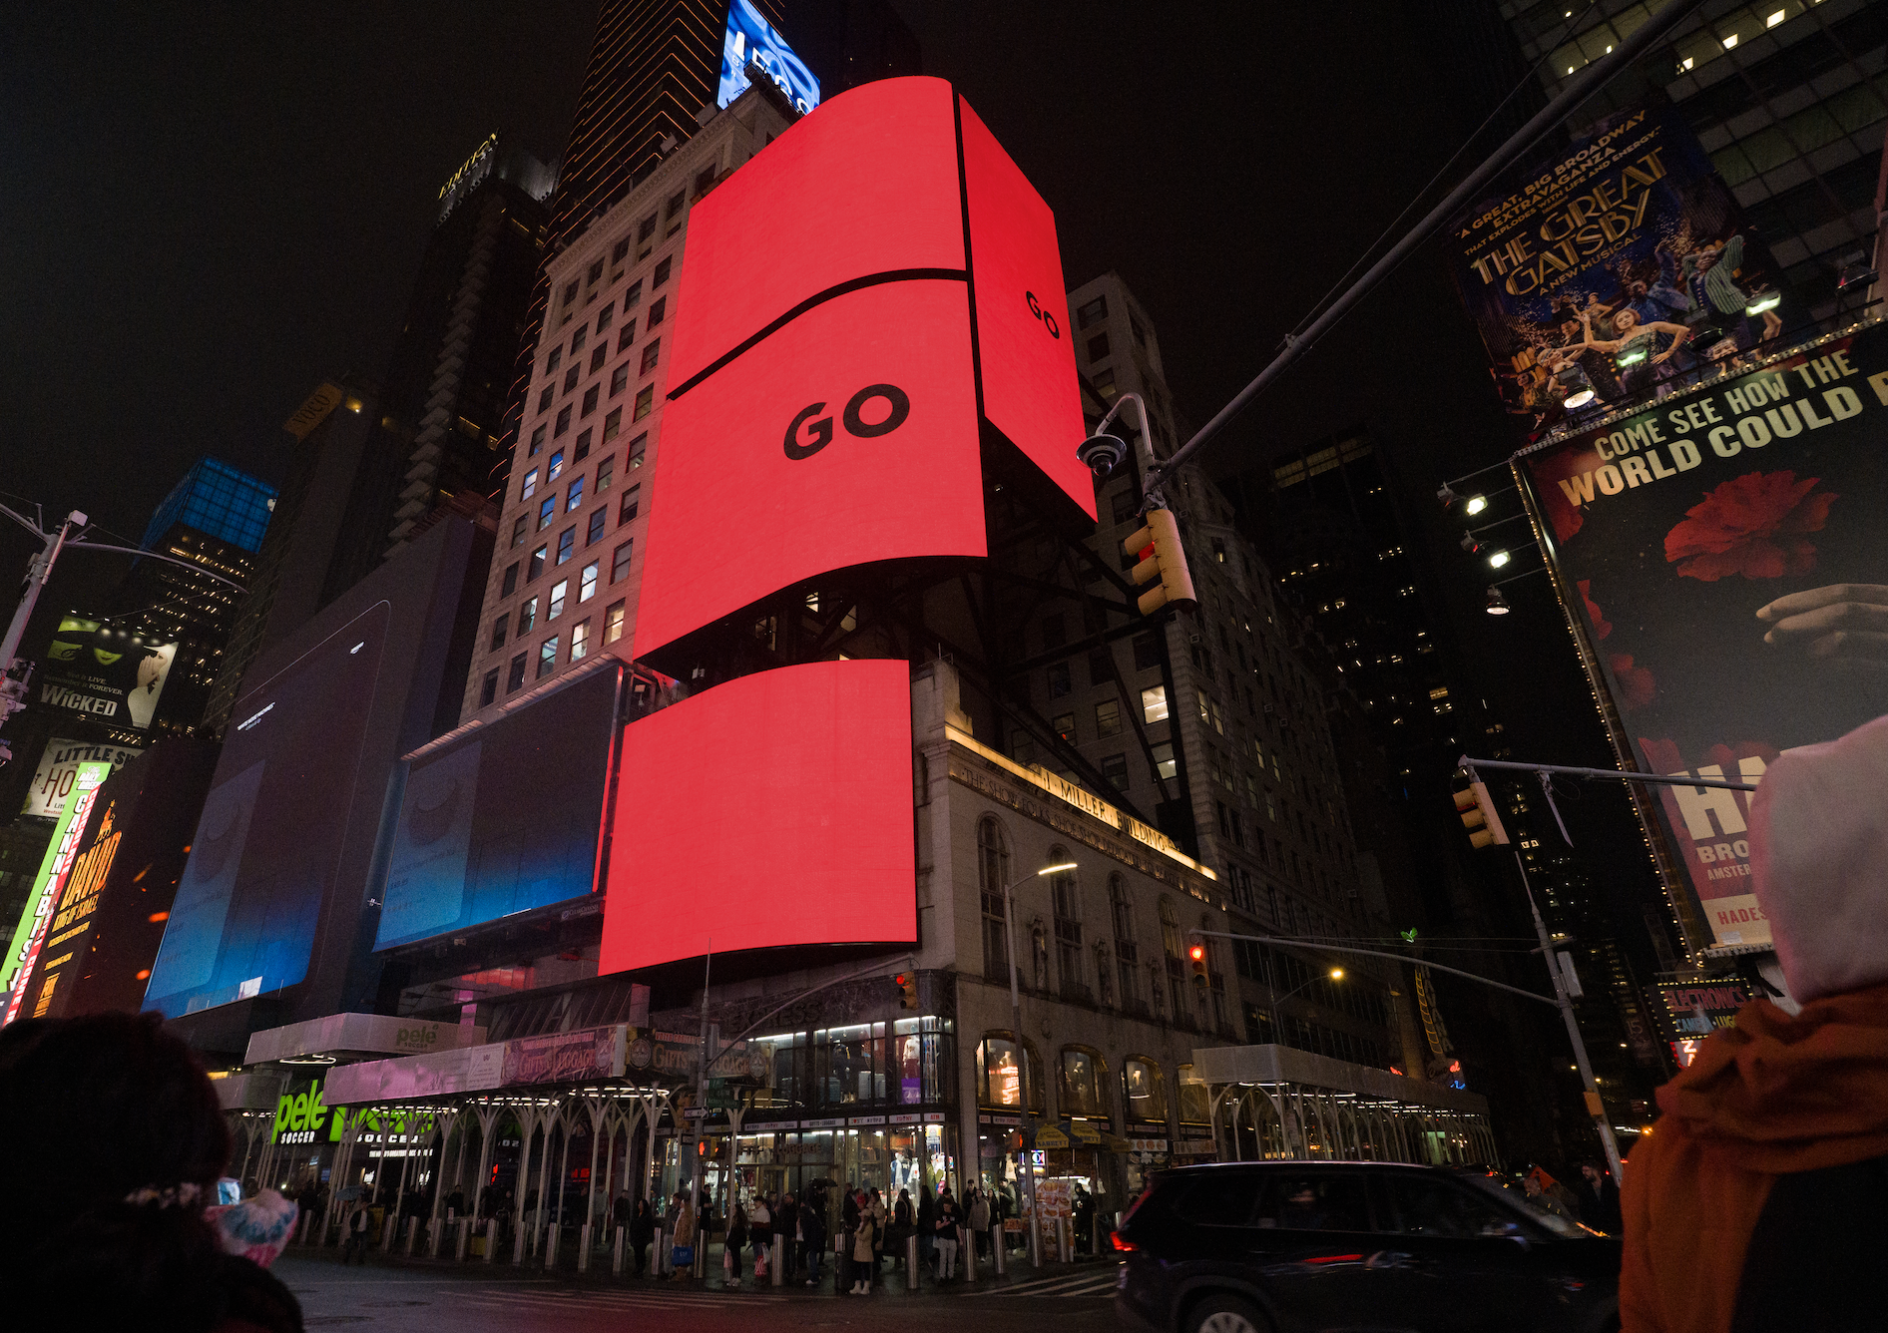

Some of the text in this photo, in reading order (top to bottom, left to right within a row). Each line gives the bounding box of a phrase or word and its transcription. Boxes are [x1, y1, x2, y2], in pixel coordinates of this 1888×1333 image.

[1464, 240, 1487, 257] THAT
[1488, 208, 1537, 242] EXPLODES
[1537, 190, 1563, 209] WITH
[1565, 177, 1587, 194] LIFE
[1588, 161, 1611, 179] AND
[1472, 193, 1523, 230] GREAT,
[1524, 173, 1552, 196] BIG
[1554, 109, 1646, 175] BROADWAY
[1493, 147, 1617, 228] EXTRAVAGANZA
[1470, 146, 1667, 285] THE GREAT
[1505, 188, 1651, 296] GATSBY
[1539, 233, 1641, 296] A NEW MUSICAL
[1026, 290, 1059, 339] GO
[783, 383, 910, 461] GO
[1594, 418, 1667, 461] COME
[1668, 397, 1723, 434] SEE
[1724, 373, 1790, 416] HOW
[1792, 348, 1859, 389] THE
[1557, 439, 1702, 508] WORLD
[1708, 386, 1864, 458] COULD
[54, 747, 113, 764] LITTLE
[1060, 779, 1108, 821] MILLER
[1115, 810, 1166, 851] BUILDING
[18, 794, 88, 961] CANNABIS
[59, 830, 123, 911] DAVID
[1664, 986, 1747, 1012] ELECTRONICS
[280, 1131, 315, 1144] SOCCER
